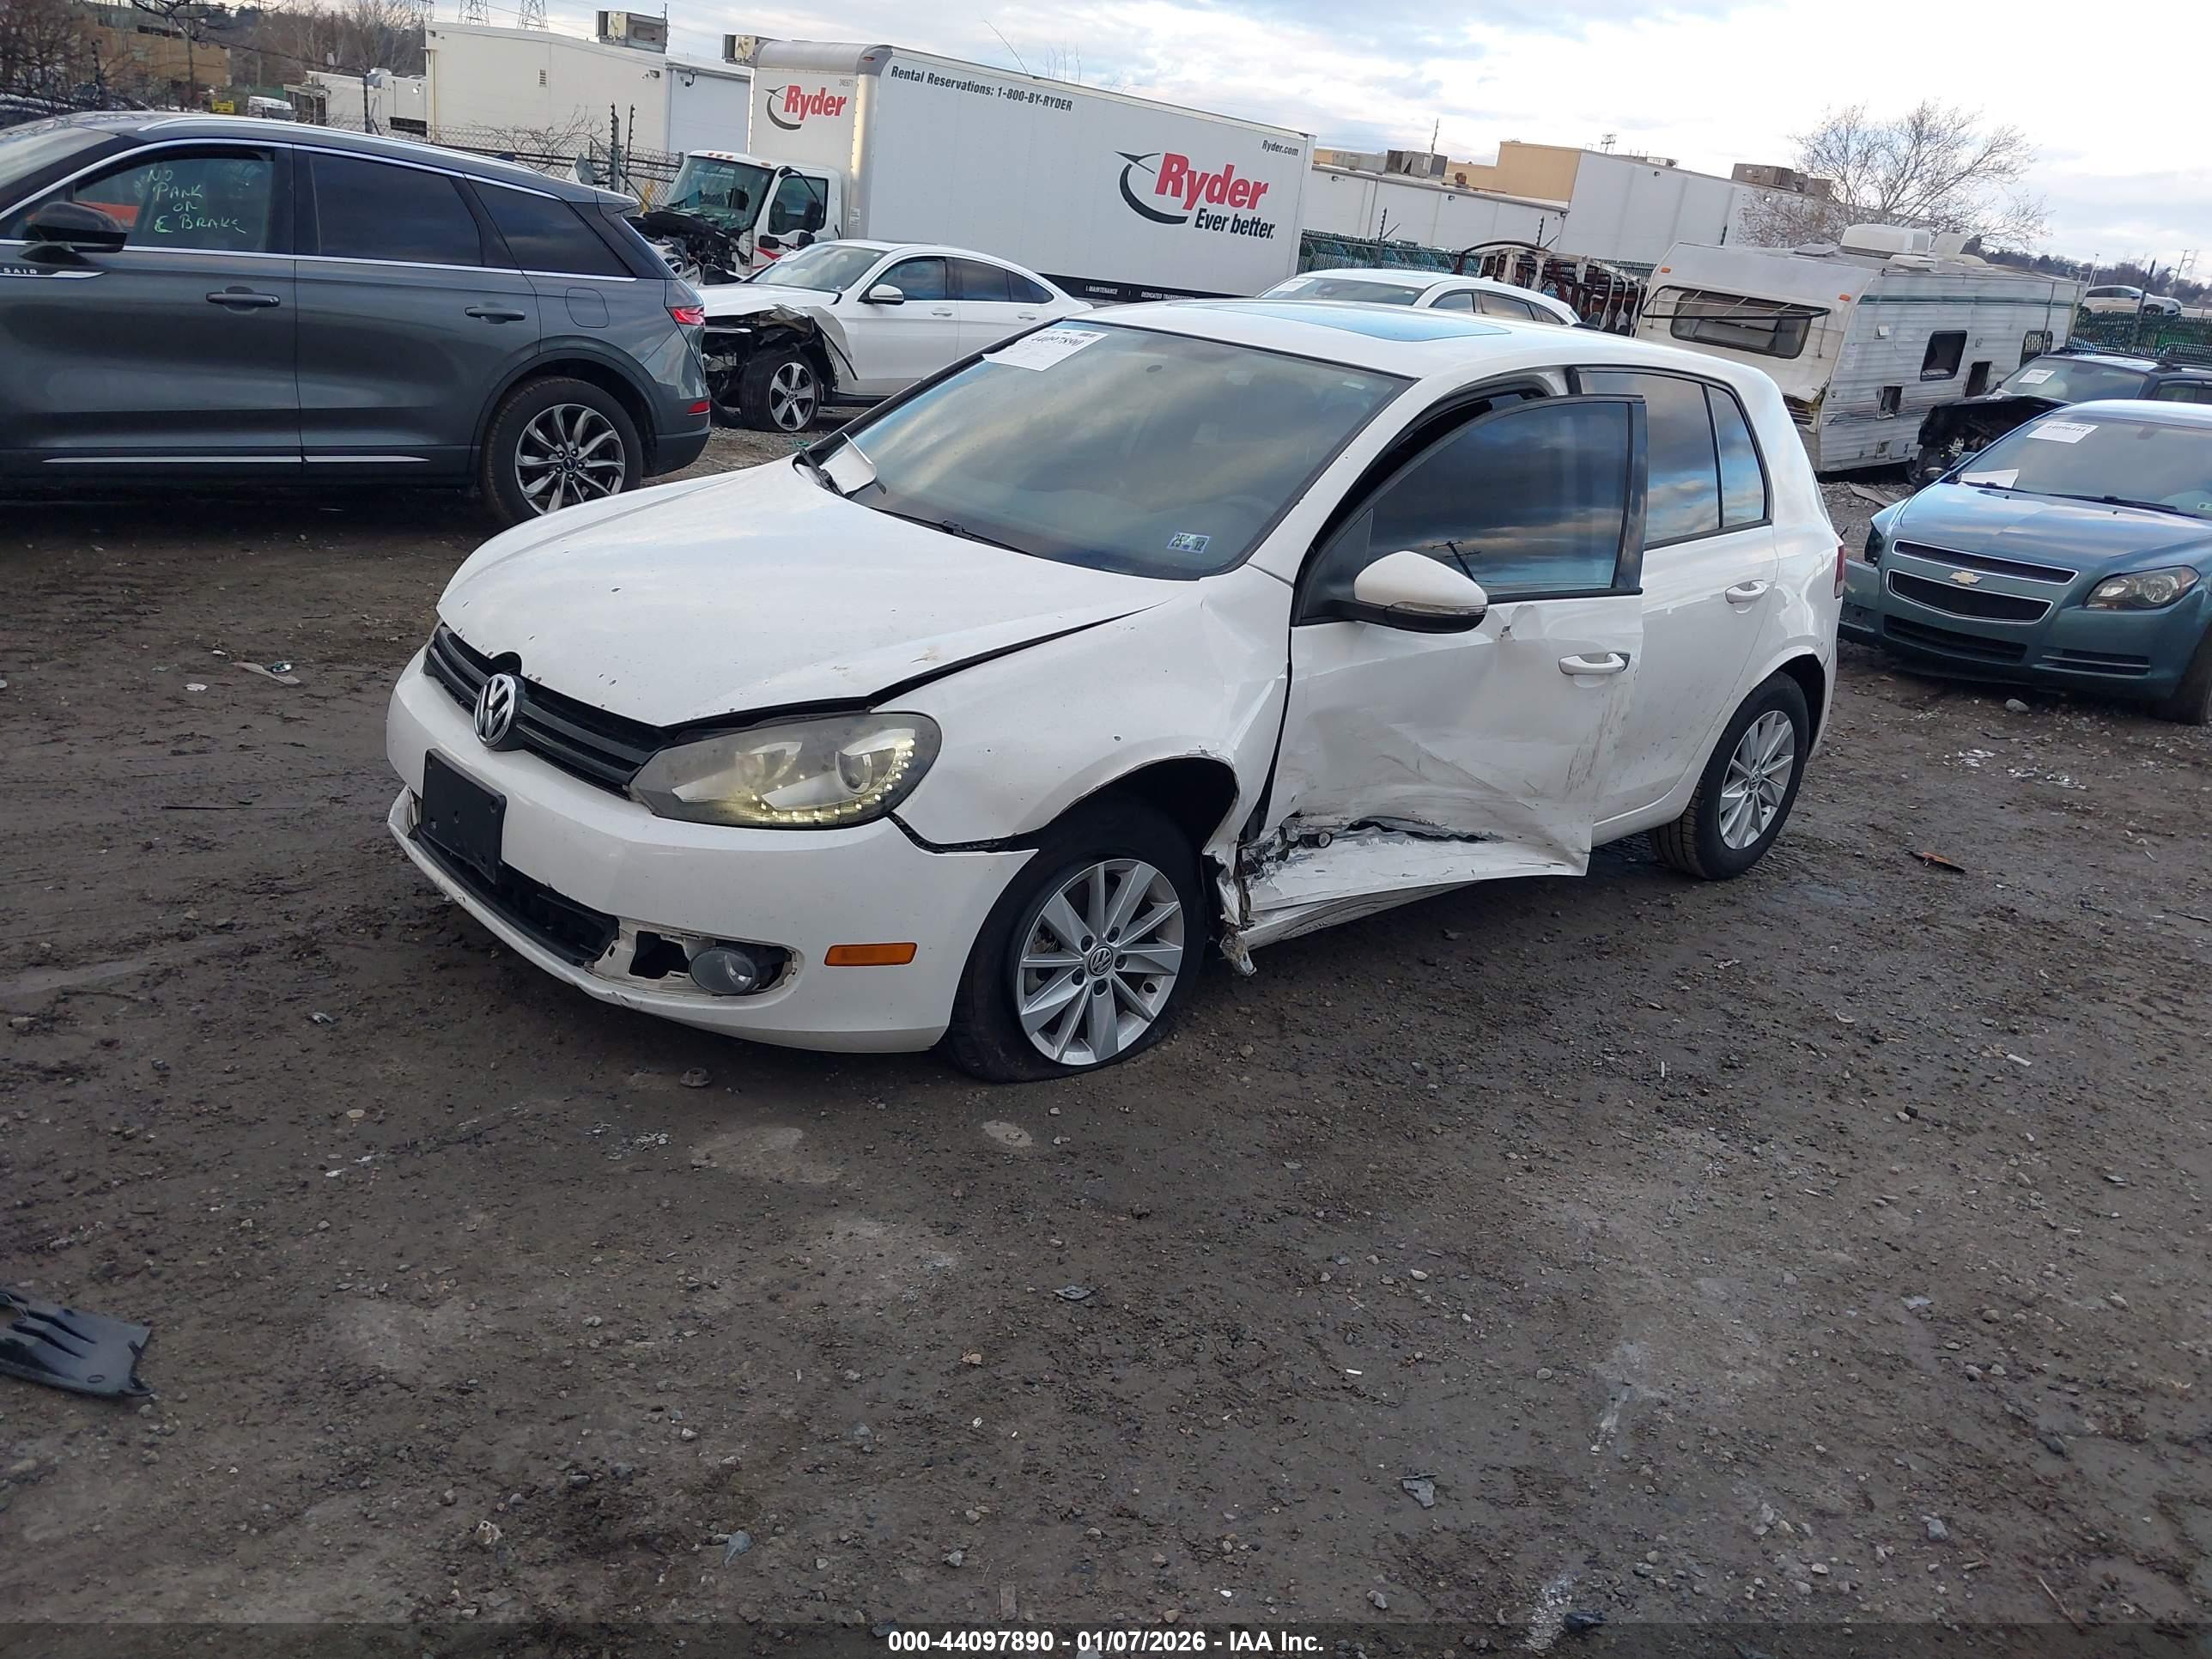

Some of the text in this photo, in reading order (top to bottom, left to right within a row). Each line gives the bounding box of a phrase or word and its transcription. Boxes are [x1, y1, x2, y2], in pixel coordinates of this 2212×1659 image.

[890, 65, 1073, 112] Rental Reservations: 1-800-BY-RYDER
[783, 84, 848, 121] Ryder
[1261, 139, 1300, 156] Ryder.com
[147, 169, 173, 183] NO
[1154, 152, 1269, 210] Ryder
[152, 182, 204, 202] PARK
[154, 213, 247, 234] E BRAKE
[1194, 207, 1276, 240] Ever better.
[3, 266, 39, 275] SAIR
[1088, 285, 1119, 295] MAINTENANCE
[1140, 290, 1163, 300] DEDICATED
[1171, 534, 1206, 551] 25 12
